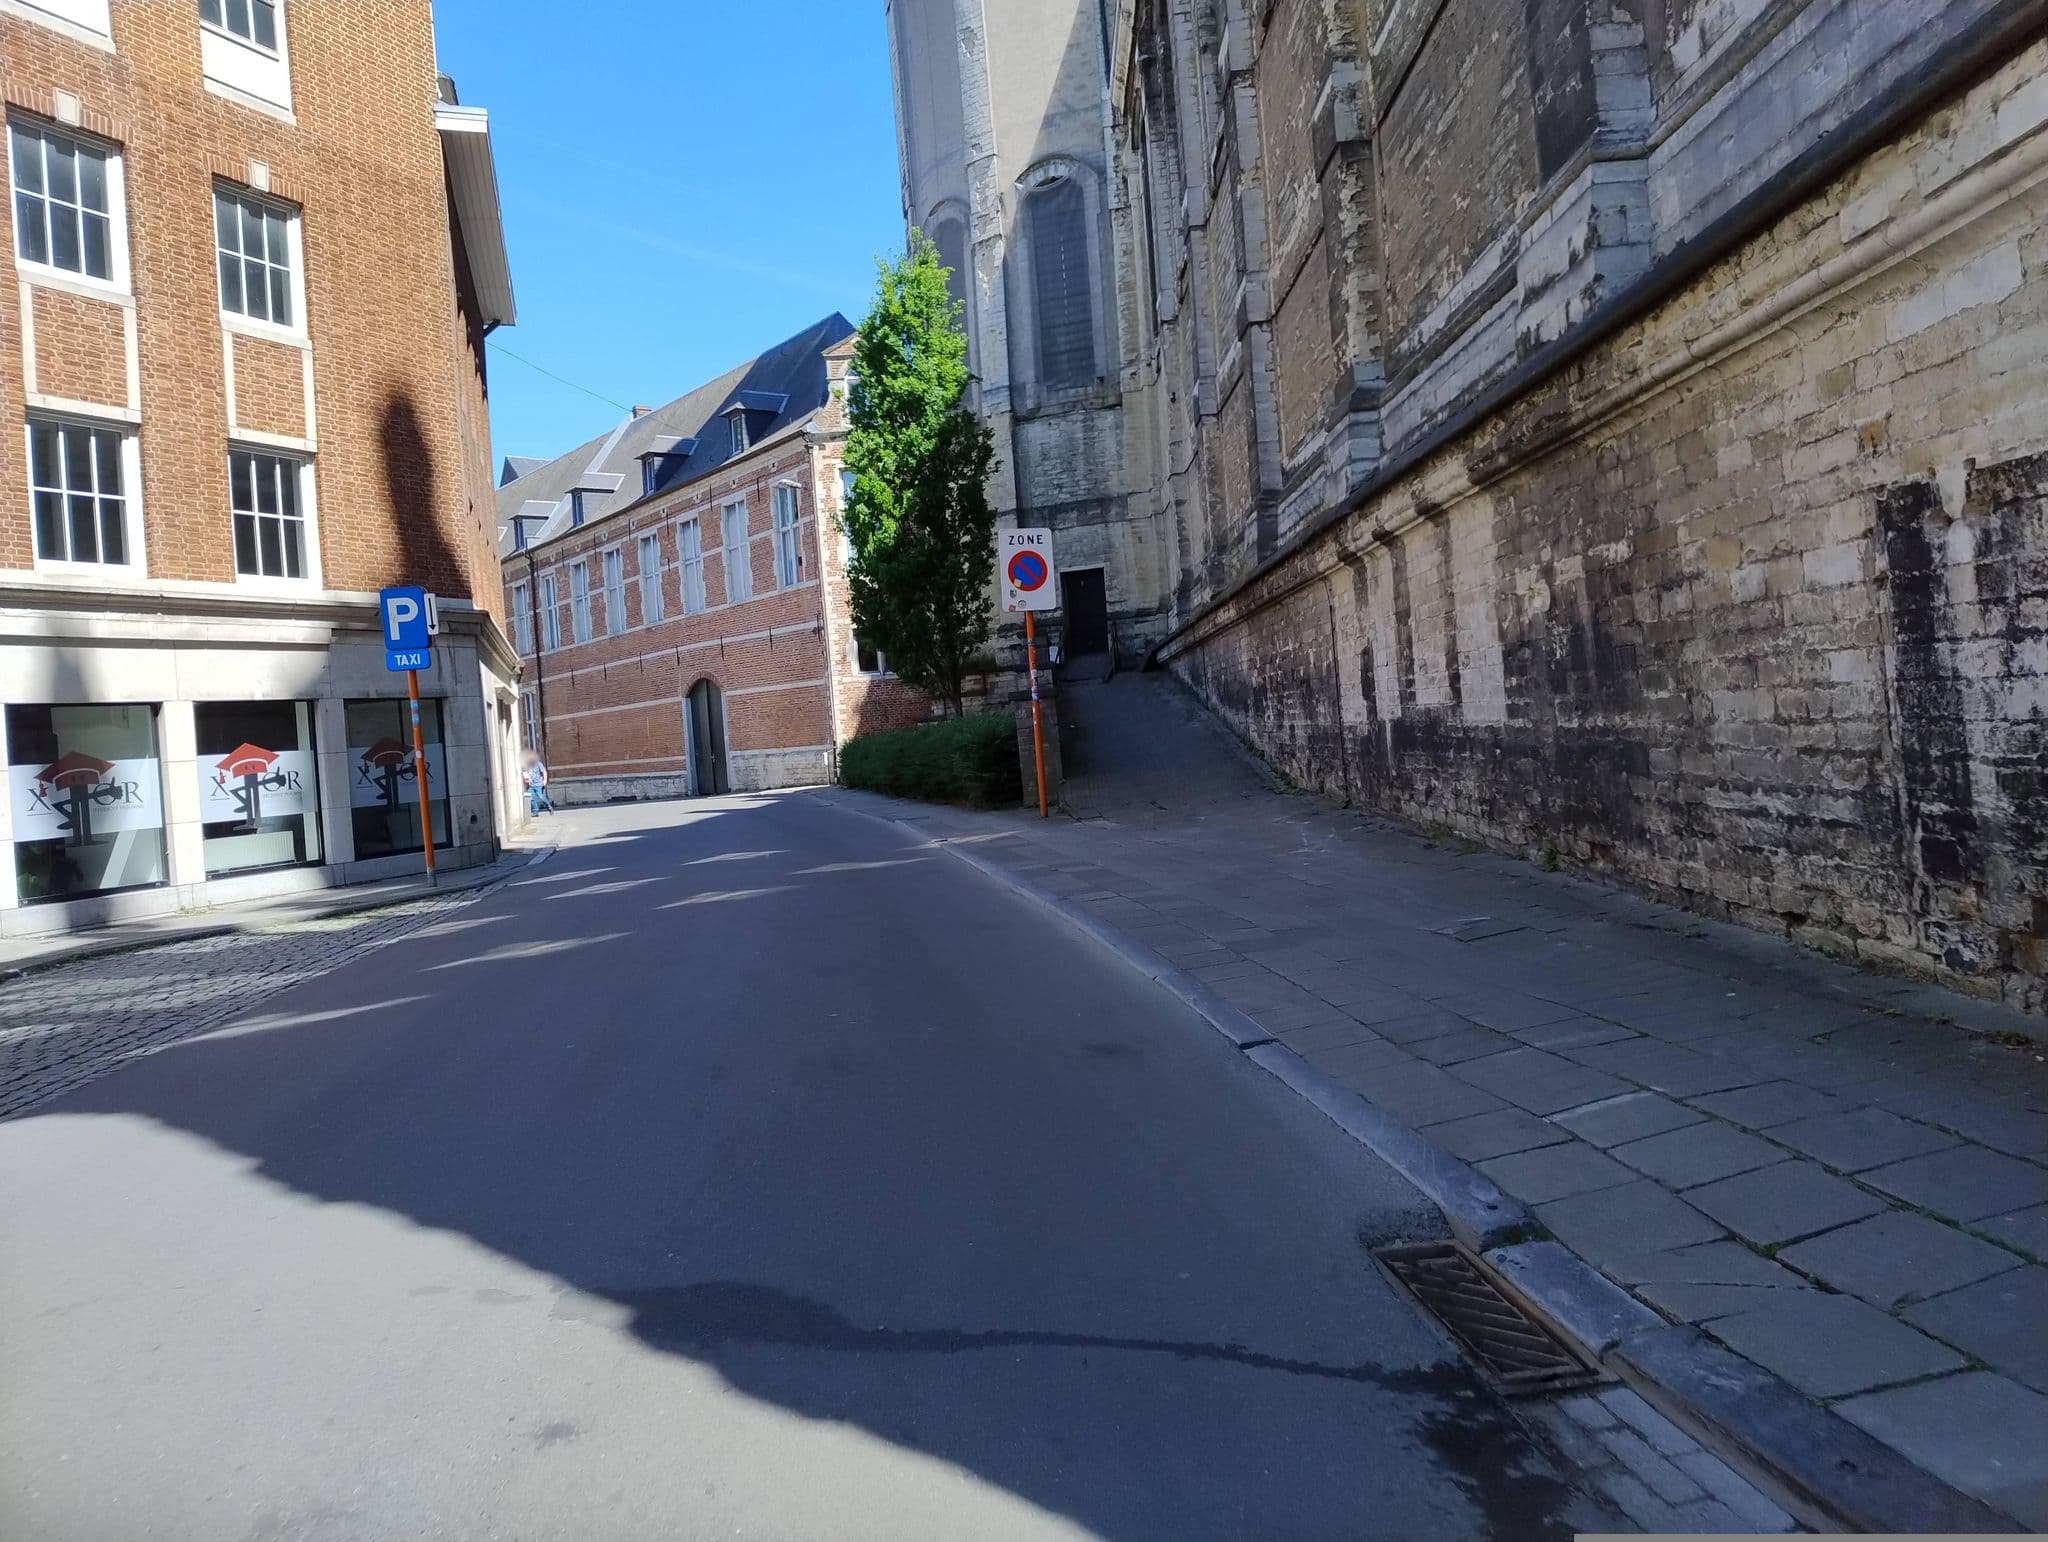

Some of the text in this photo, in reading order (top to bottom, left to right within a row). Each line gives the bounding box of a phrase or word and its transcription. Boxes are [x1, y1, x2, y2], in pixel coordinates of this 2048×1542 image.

[1008, 534, 1044, 545] ZONE
[387, 597, 418, 640] P
[395, 653, 421, 666] TAXI
